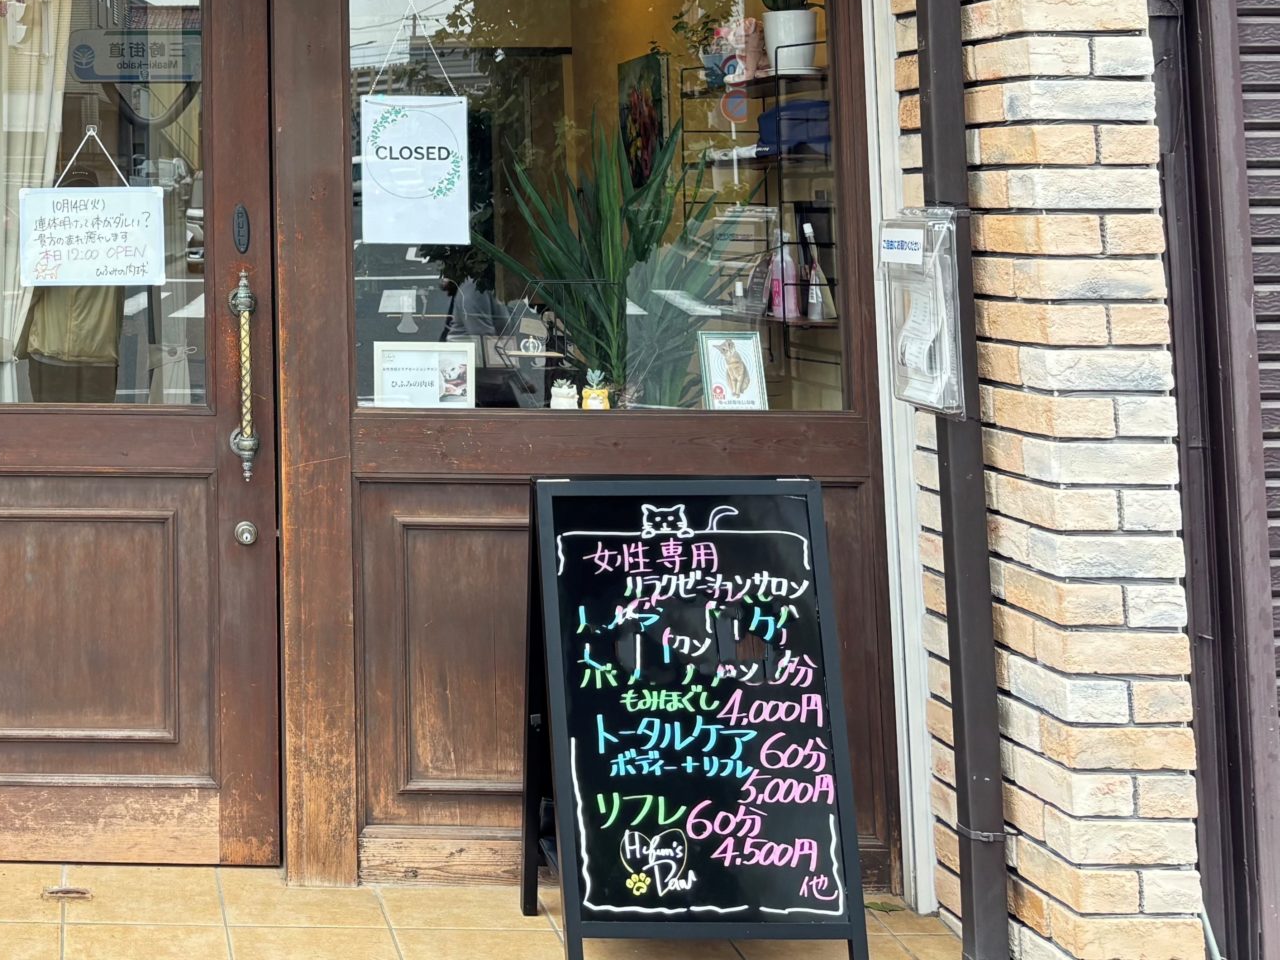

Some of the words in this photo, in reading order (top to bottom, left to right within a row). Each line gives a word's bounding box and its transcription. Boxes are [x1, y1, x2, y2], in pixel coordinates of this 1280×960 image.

[375, 146, 451, 161] CLOSED
[106, 245, 148, 259] OPEN
[620, 685, 720, 712] もみほぐし
[597, 714, 758, 759] トータルケア
[760, 732, 828, 772] 60分
[597, 792, 688, 829] リフレ
[686, 800, 768, 840] 60分
[799, 874, 839, 900] 他
